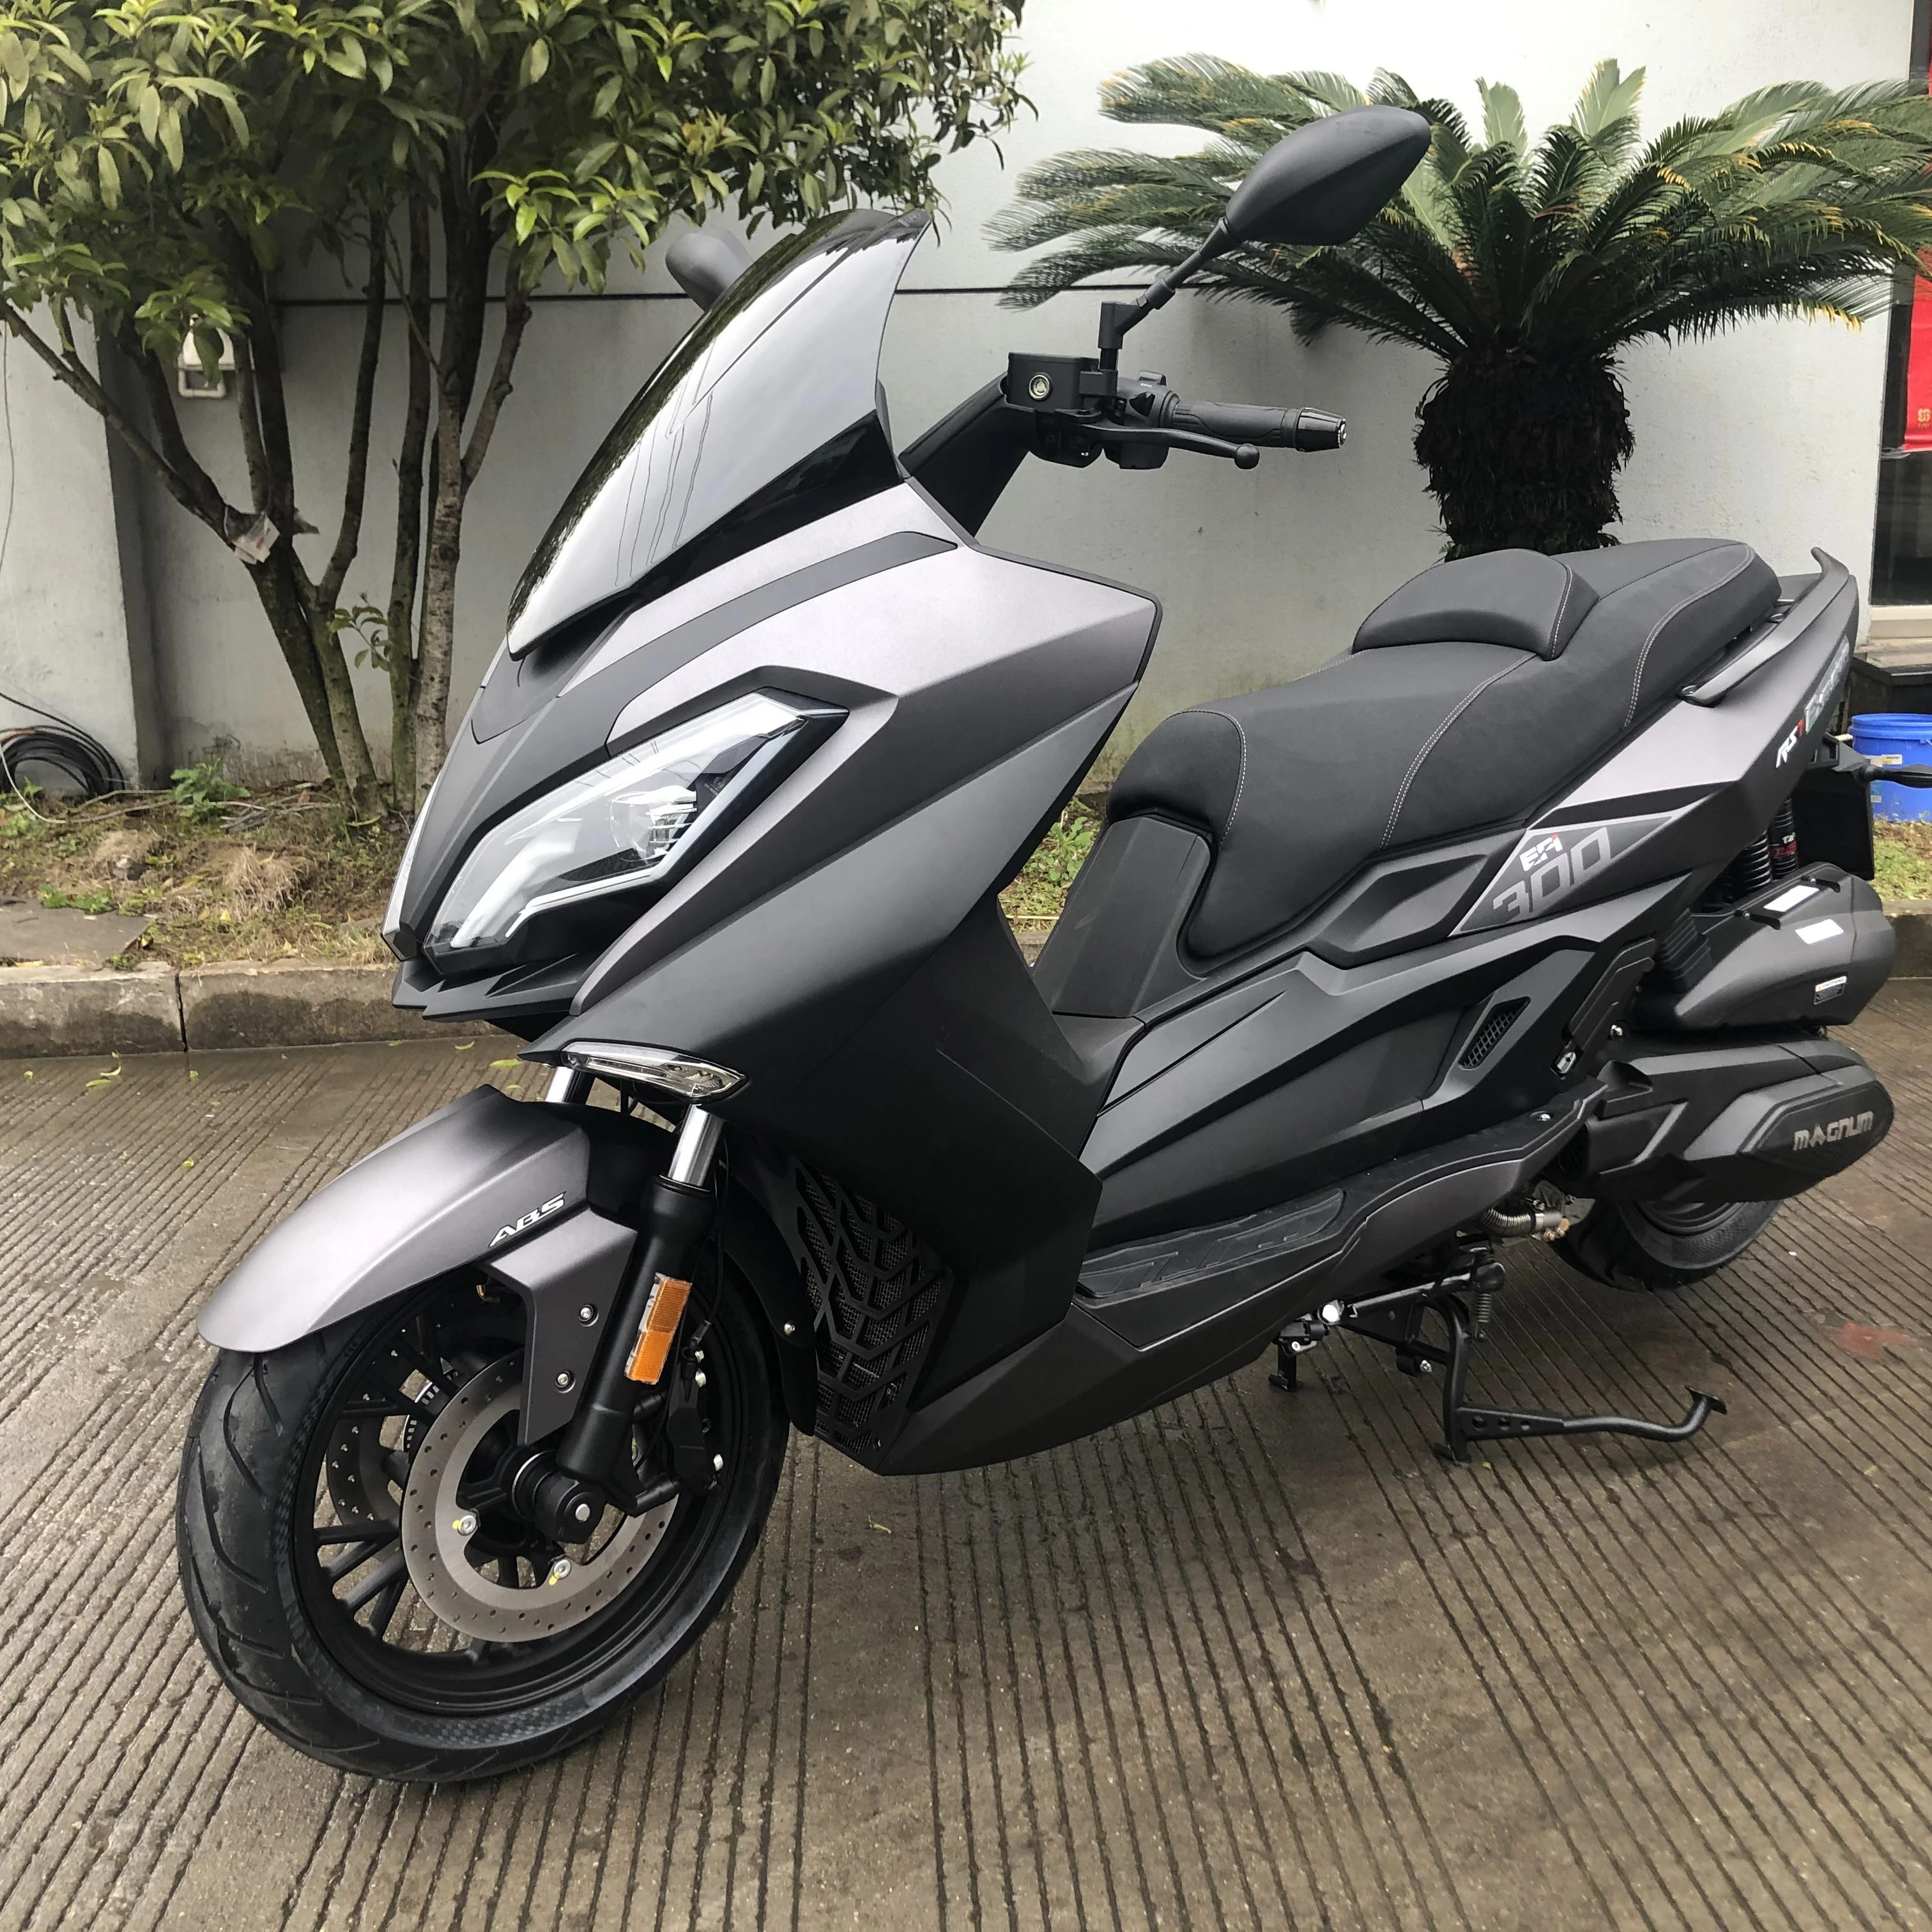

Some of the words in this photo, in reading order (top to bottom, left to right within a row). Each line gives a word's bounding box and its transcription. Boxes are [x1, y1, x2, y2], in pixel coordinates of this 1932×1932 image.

[1492, 826, 1611, 921] 300
[1793, 1111, 1873, 1151] MAGNUM
[488, 1191, 566, 1247] ABS
